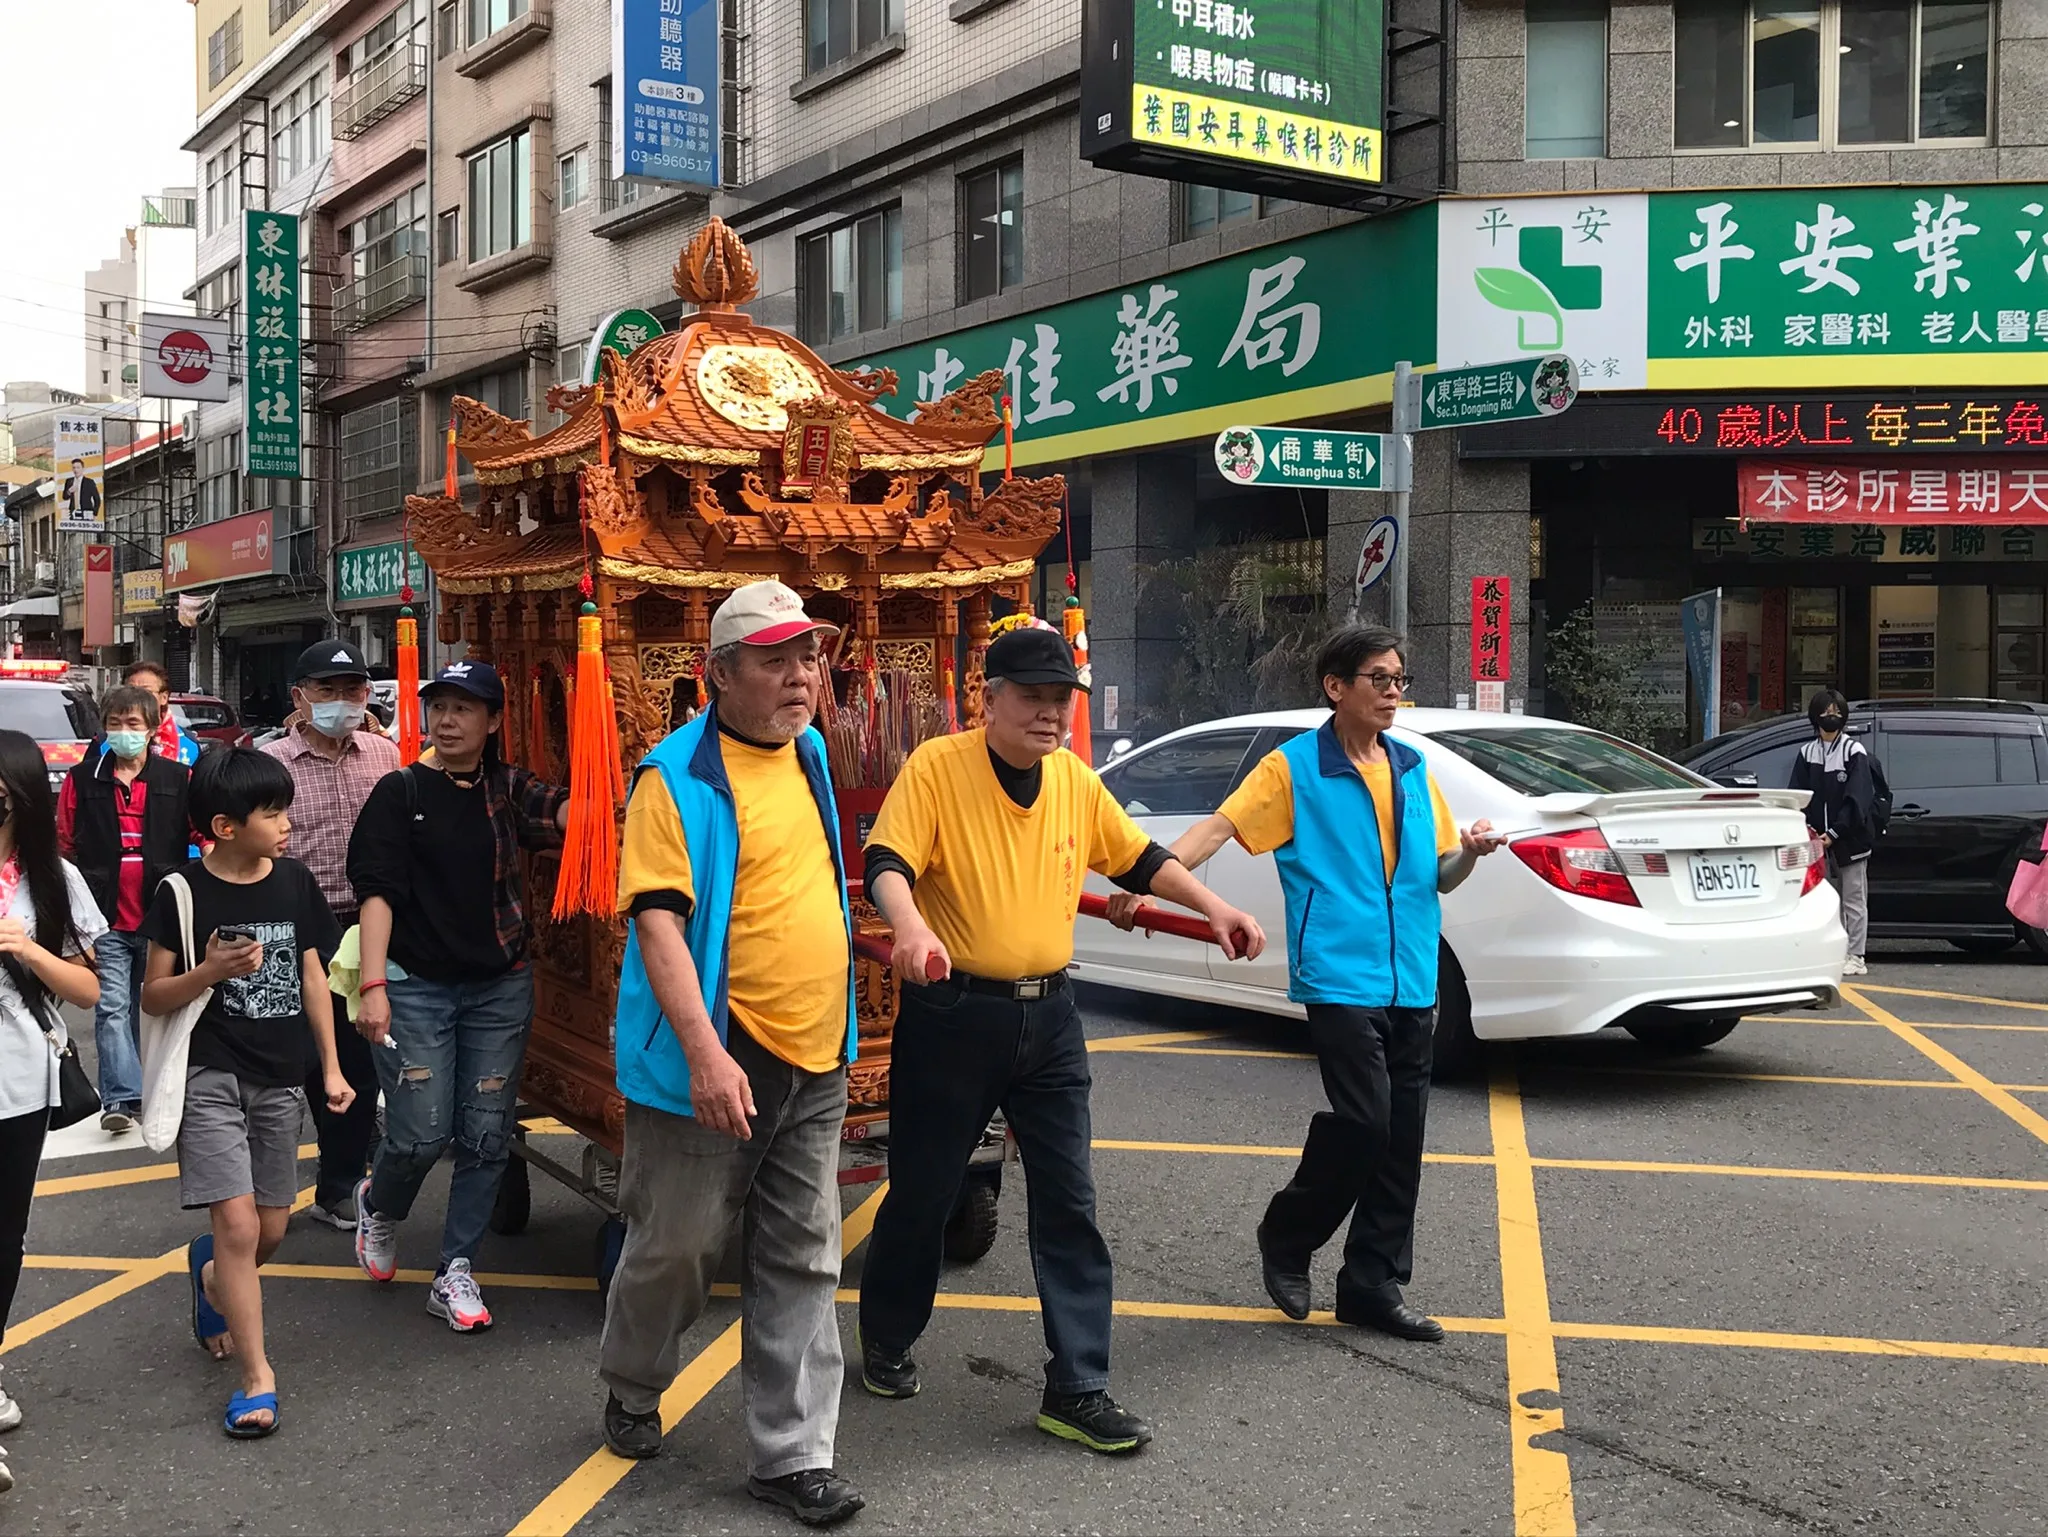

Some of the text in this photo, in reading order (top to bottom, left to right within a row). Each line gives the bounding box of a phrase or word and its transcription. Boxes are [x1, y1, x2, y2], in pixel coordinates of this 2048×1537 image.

[1171, 0, 1255, 40] 中耳積水
[1170, 44, 1255, 92] 喉異物症
[1143, 94, 1373, 175] 葉國安耳鼻喉科診所
[631, 150, 712, 172] 03-5960517
[254, 219, 293, 425] 東林旅行社
[1684, 315, 1754, 349] 外科
[1784, 312, 1892, 347] 家醫科
[159, 345, 213, 372] SYM
[856, 256, 1321, 431] 佳藥局
[1578, 358, 1621, 378] 全家
[1436, 371, 1514, 403] 東寧路三段
[1461, 402, 1499, 416] Dongning
[1501, 399, 1514, 411] Rd.
[1656, 407, 1701, 444] 40
[1717, 404, 1853, 447] 歲以上
[1282, 437, 1364, 465] 商華街
[1282, 464, 1364, 481] Shanghua St.
[1756, 469, 2048, 513] 本診所星期天
[1479, 579, 1504, 677] 恭賀新禧
[1695, 864, 1760, 892] ABN-5172
